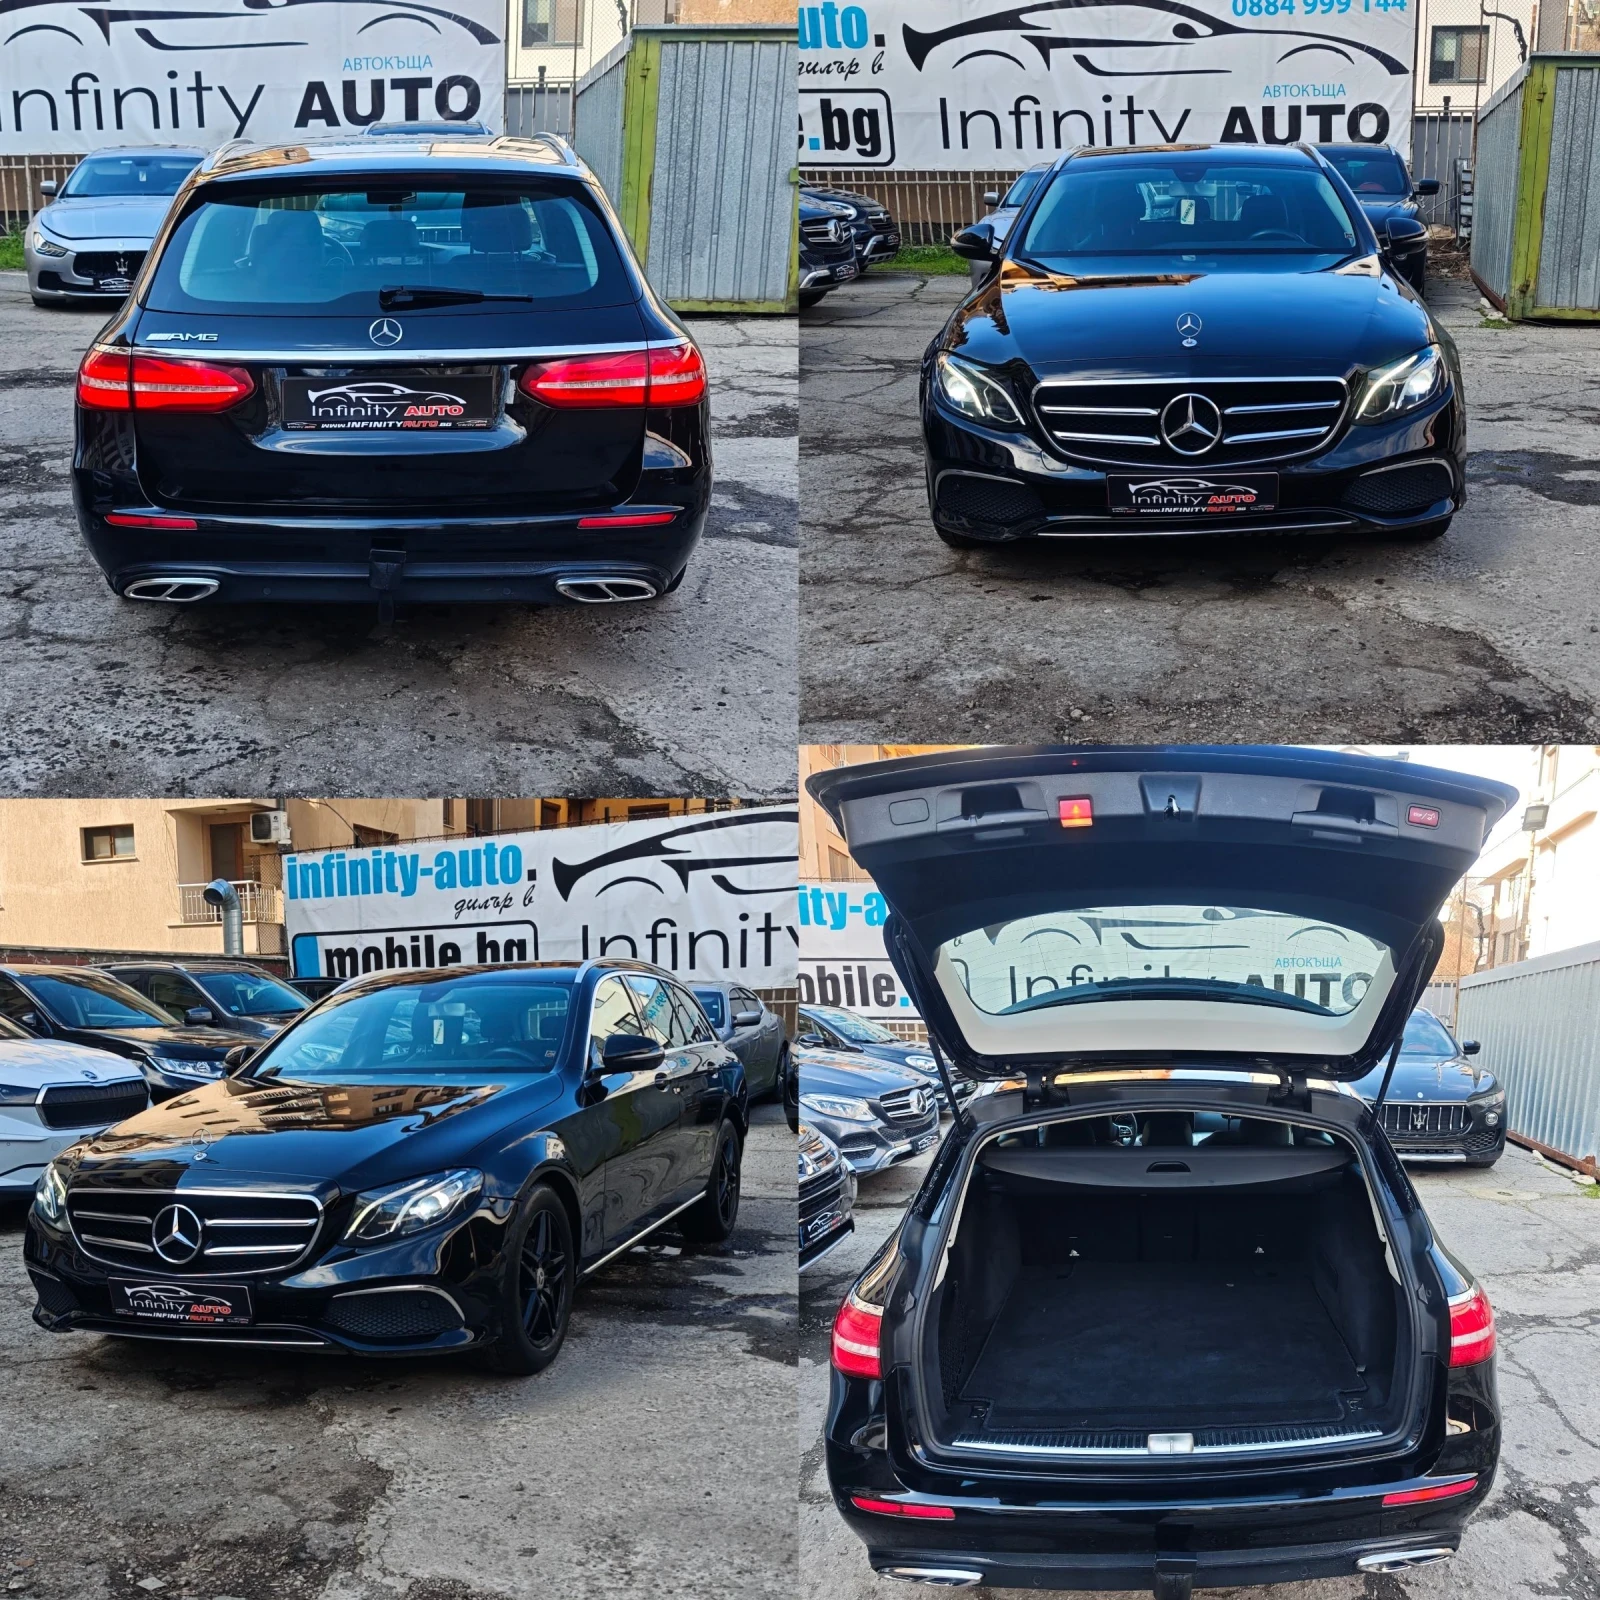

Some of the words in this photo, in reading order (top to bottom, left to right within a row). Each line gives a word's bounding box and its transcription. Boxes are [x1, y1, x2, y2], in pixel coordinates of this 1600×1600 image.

[1232, 0, 1295, 17] 0884
[1304, 0, 1351, 15] 999
[342, 54, 433, 72] АВТОКЪЩА
[1262, 83, 1346, 98] АВТОКЪЩА
[0, 70, 265, 138] nfinity
[294, 75, 481, 128] AUTO
[799, 98, 882, 158] .bg
[939, 94, 1192, 149] Infinity
[1220, 102, 1390, 144] AUTO
[167, 333, 218, 341] AMG
[312, 404, 397, 418] Infinity
[404, 404, 464, 416] AUTO
[1132, 494, 1202, 505] Infinity
[1208, 494, 1256, 504] AUTO
[1275, 956, 1342, 969] АВТОКЪЩА
[129, 1298, 186, 1312] Infinity
[190, 1304, 232, 1315] AUTO
